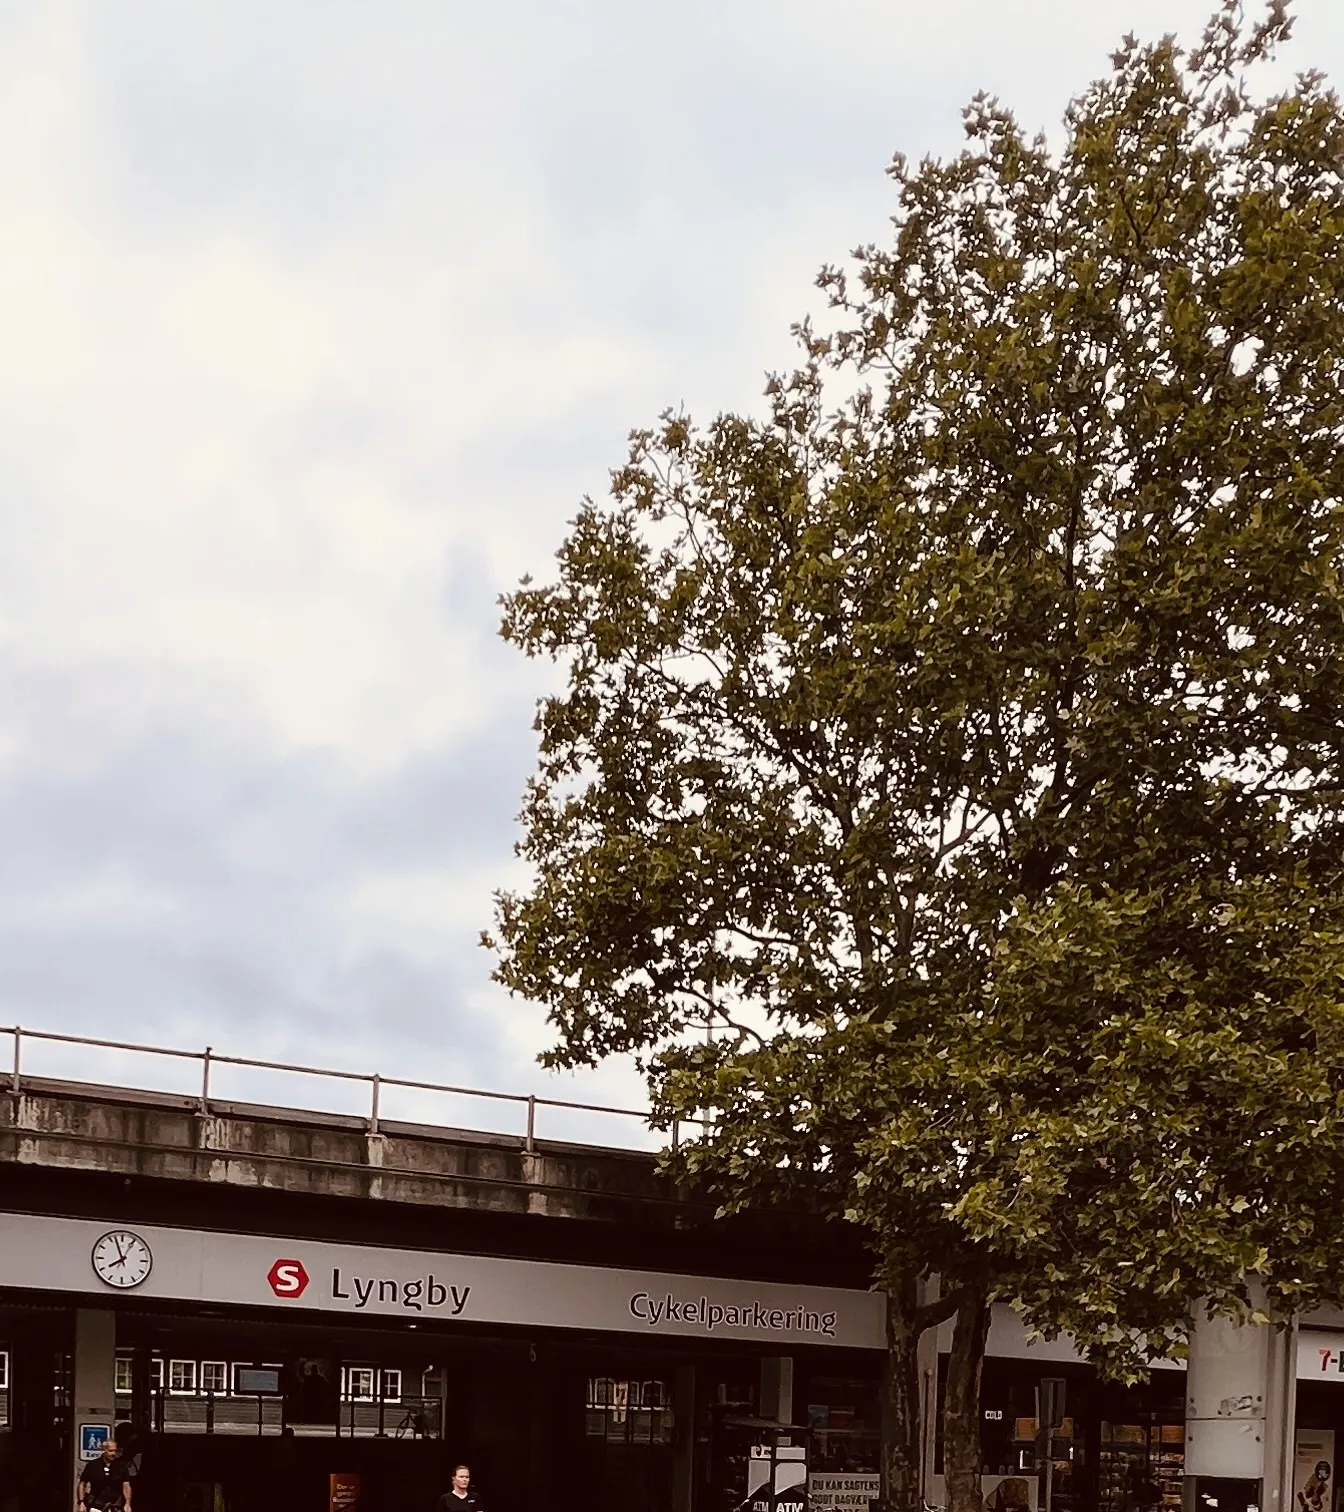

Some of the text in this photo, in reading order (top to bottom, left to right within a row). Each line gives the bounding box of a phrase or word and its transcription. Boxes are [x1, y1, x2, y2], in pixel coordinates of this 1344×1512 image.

[330, 1266, 472, 1317] Lyngby
[629, 1291, 838, 1338] Cykelparkering
[812, 1479, 824, 1491] DU
[825, 1480, 843, 1491] KAN
[753, 1501, 769, 1512] ATM
